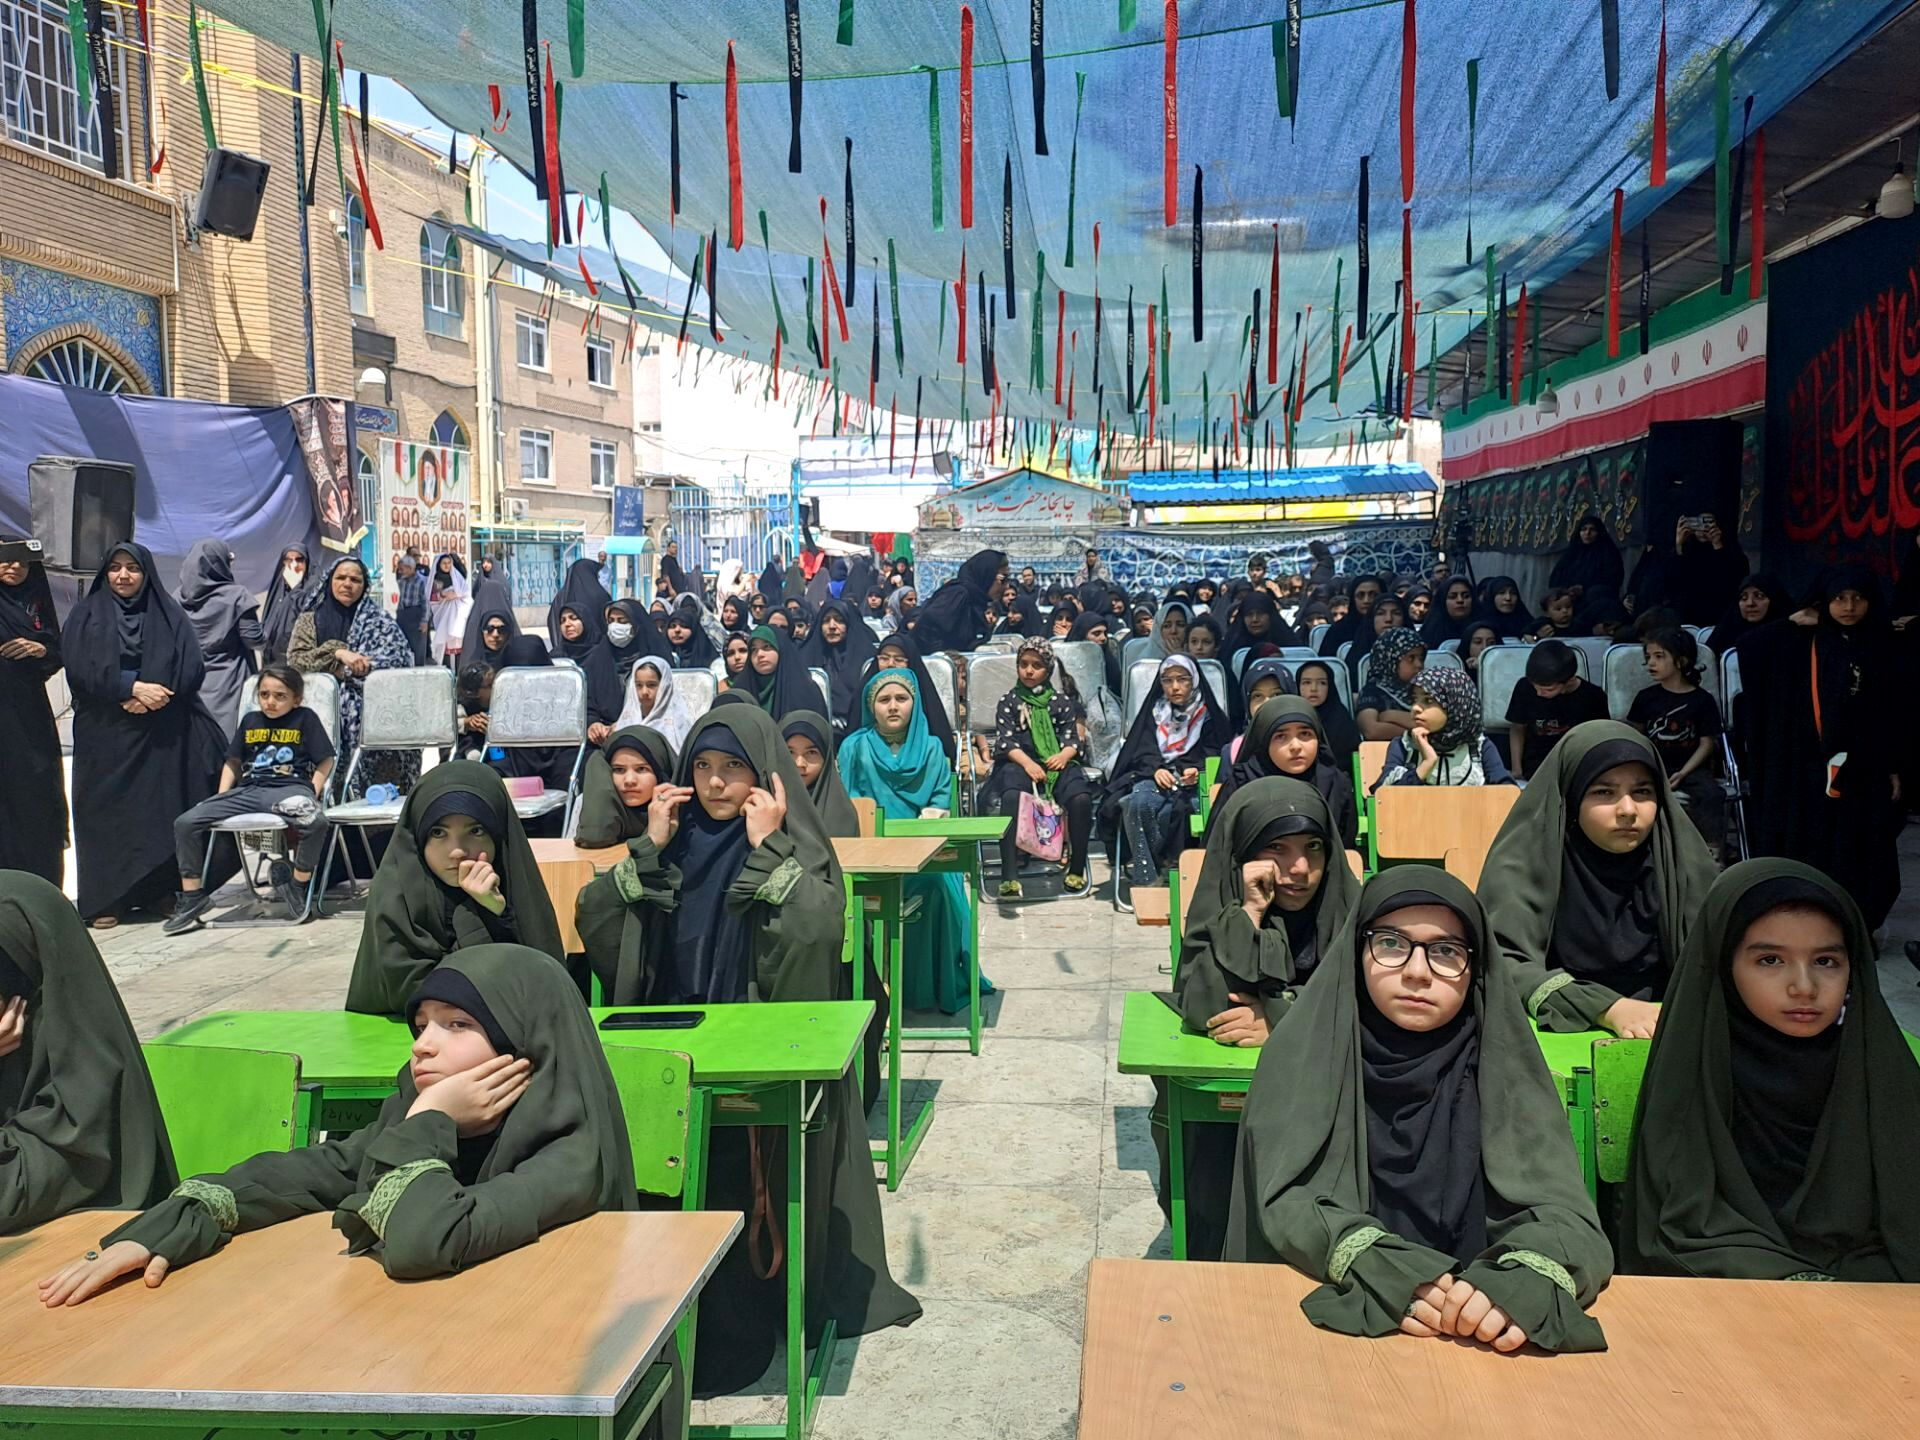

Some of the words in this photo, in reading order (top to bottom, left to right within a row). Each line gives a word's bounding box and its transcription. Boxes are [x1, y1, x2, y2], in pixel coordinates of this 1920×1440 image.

[976, 494, 997, 512] رضا
[997, 486, 1042, 516] حضرت
[1039, 492, 1074, 522] چایخانه
